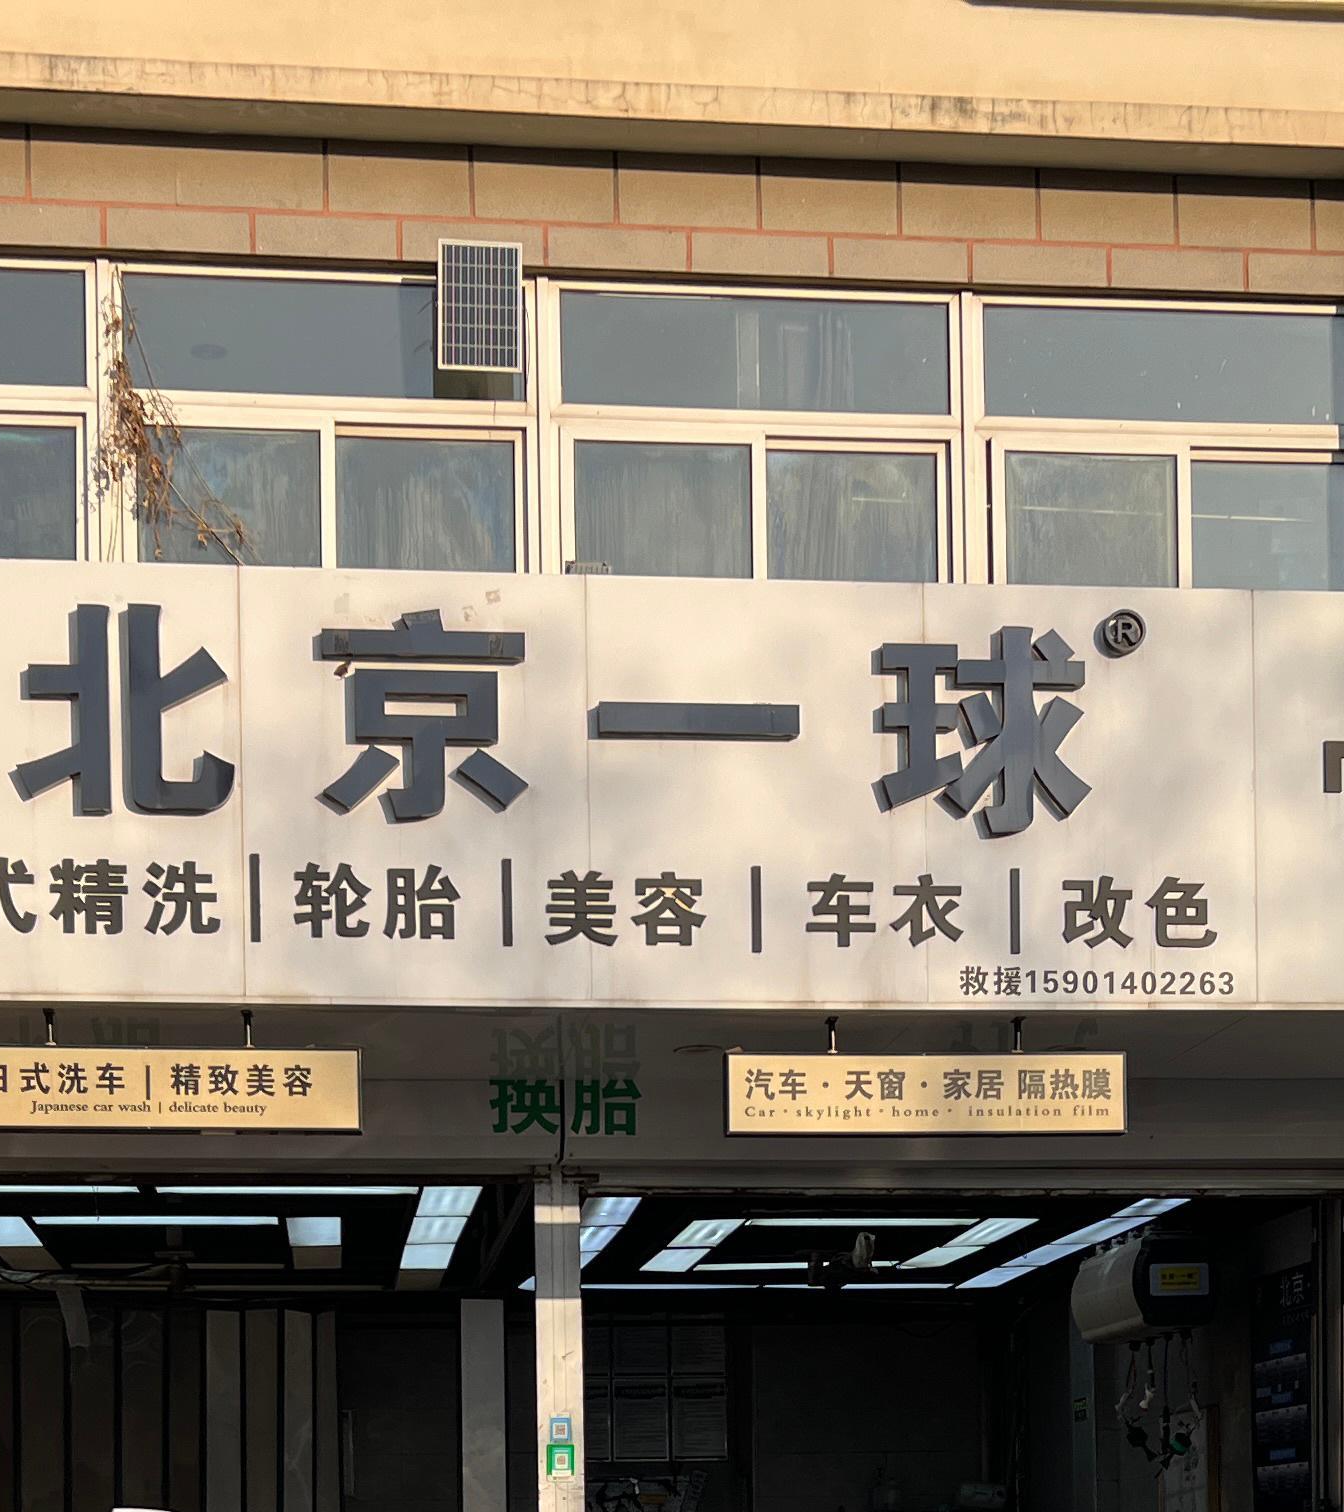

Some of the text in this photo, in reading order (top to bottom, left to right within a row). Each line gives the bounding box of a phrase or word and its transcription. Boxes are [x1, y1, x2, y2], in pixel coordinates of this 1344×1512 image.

[8, 604, 1092, 839] 北京一球
[294, 862, 460, 940] 轮胎
[545, 870, 706, 946] 美容
[806, 873, 964, 947] 车衣
[1062, 876, 1217, 949] 改色
[960, 965, 1235, 997] 救援15901402263
[171, 1063, 313, 1097] 精致美容
[1017, 1068, 1112, 1101] 隔热膜
[30, 1101, 267, 1116] Japanese car wash delicate beauty
[489, 1080, 642, 1135] 换胎
[744, 1105, 1110, 1121] Car skylight home insulation film
